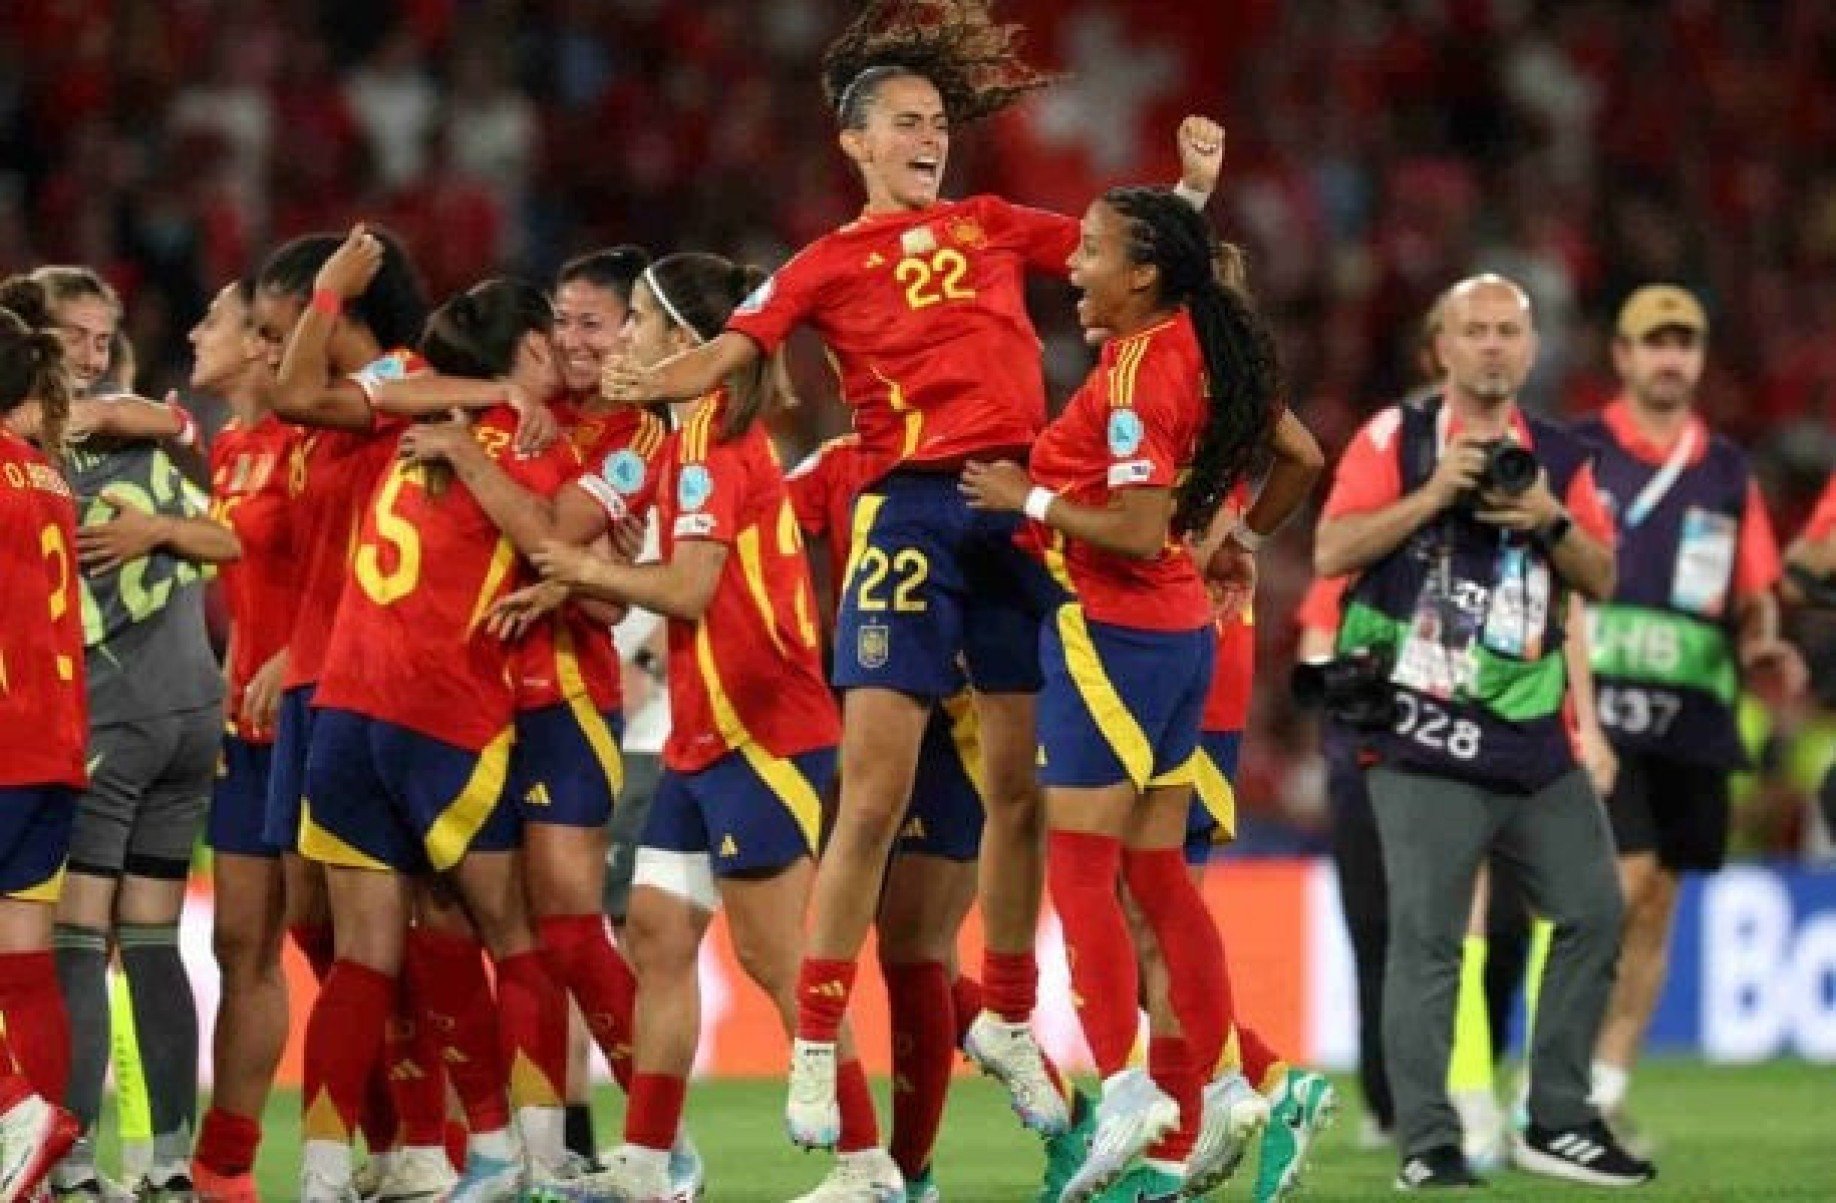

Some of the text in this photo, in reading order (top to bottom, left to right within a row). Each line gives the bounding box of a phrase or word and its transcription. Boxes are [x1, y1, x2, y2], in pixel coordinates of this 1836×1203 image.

[896, 249, 976, 310] 22
[355, 458, 423, 605] 5
[857, 547, 928, 612] 22
